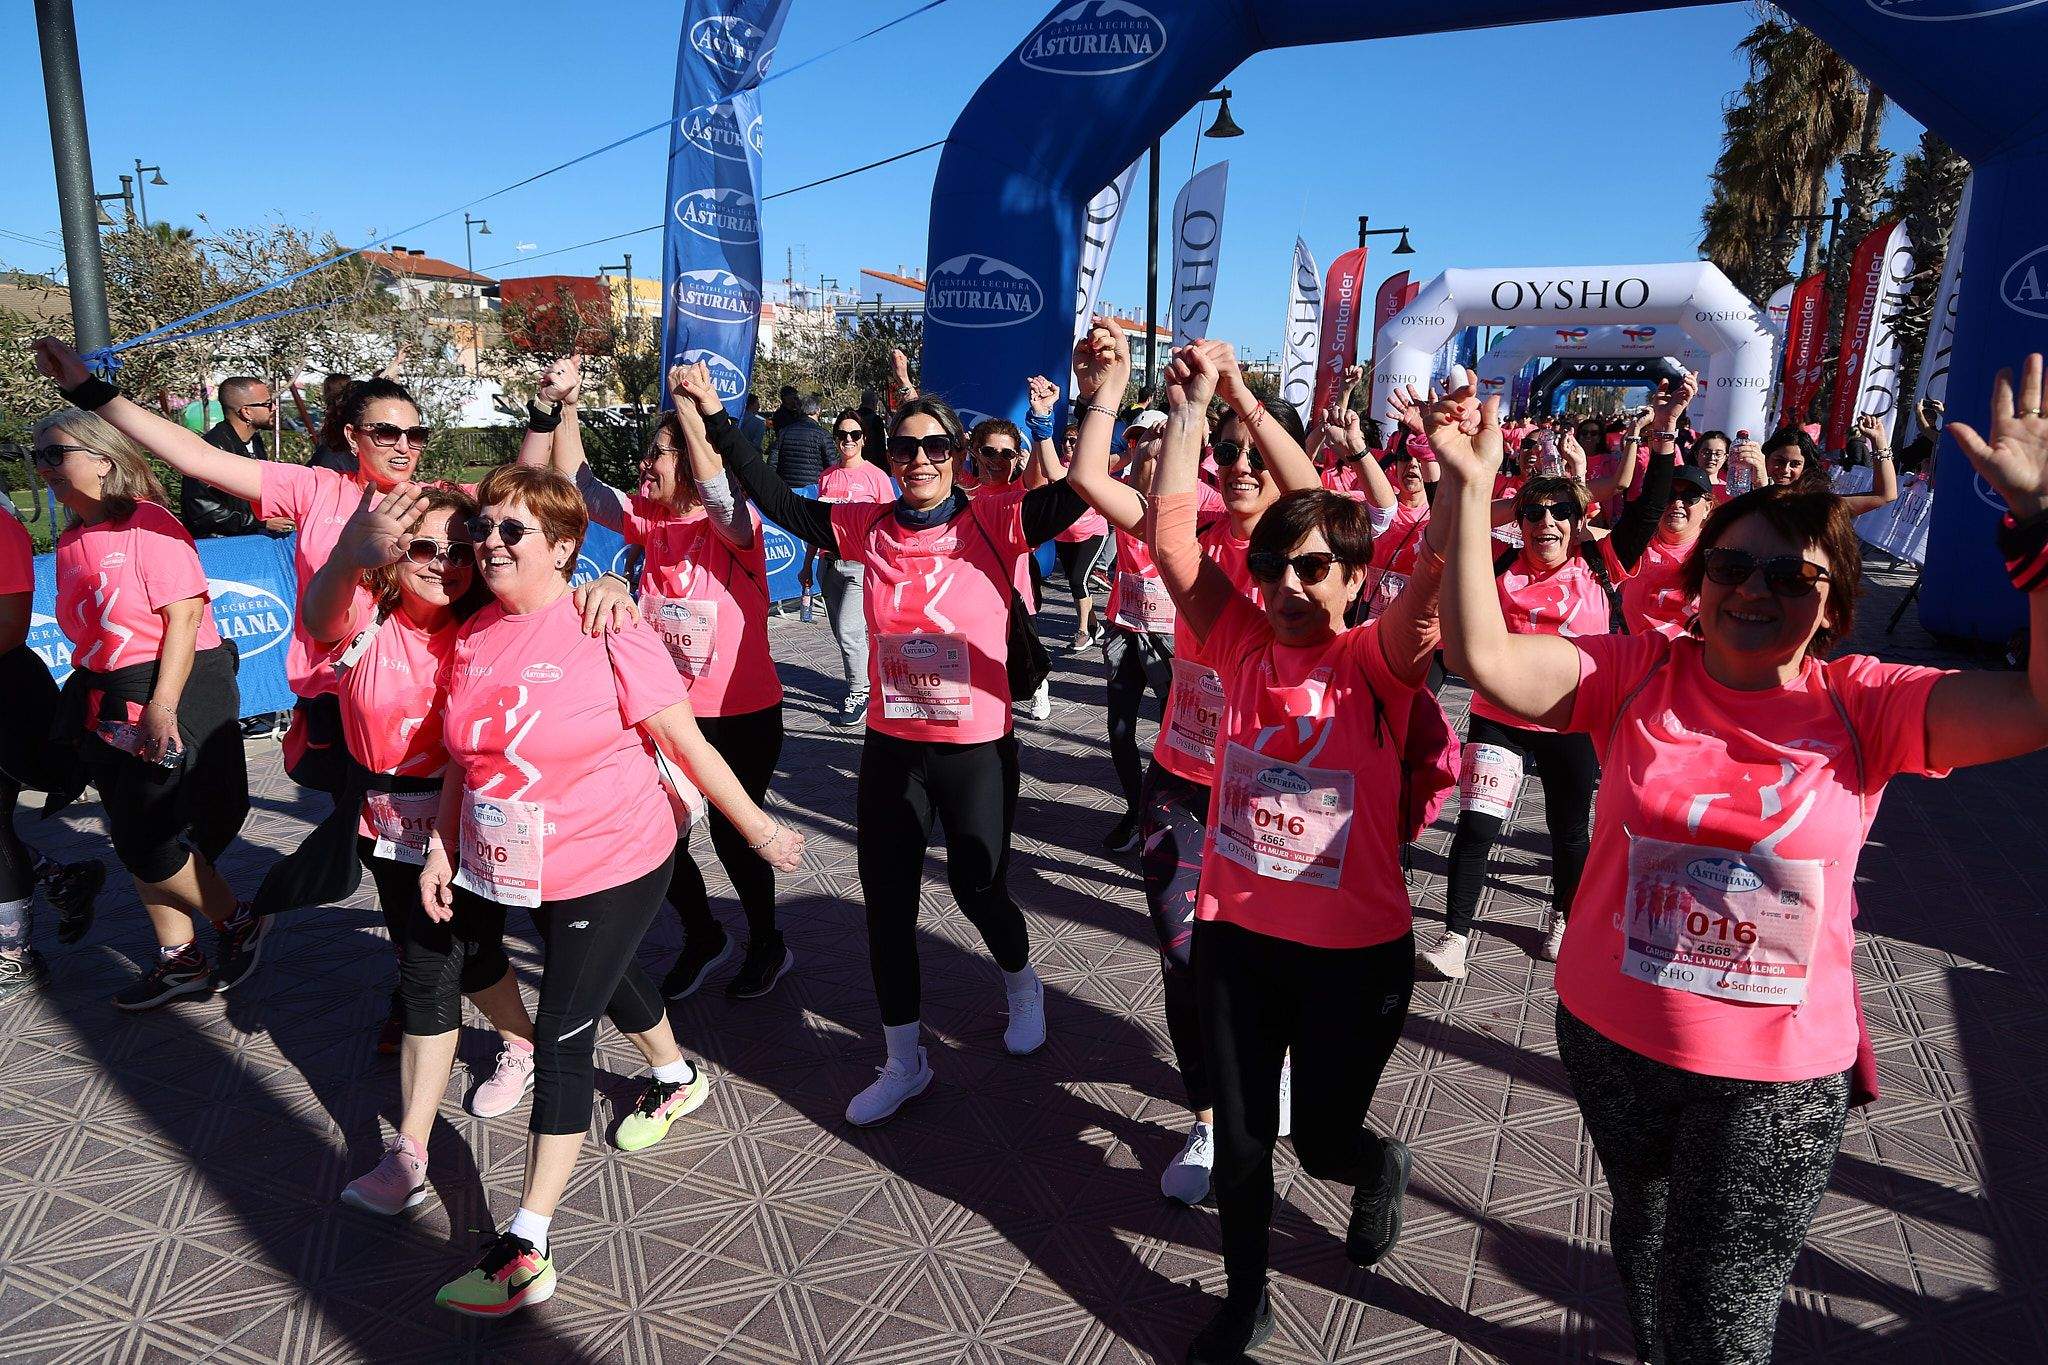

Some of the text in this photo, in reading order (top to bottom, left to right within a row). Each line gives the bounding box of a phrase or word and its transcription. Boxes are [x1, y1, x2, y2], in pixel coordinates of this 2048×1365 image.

[1026, 34, 1153, 60] ASTURIANA
[928, 282, 1032, 312] ASTURIANA
[1491, 278, 1649, 310] OYSHO
[1852, 252, 1883, 350] Santander
[1333, 272, 1354, 351] Santander
[1401, 316, 1445, 326] OYSHO
[1696, 311, 1747, 322] OYSHO
[1797, 296, 1815, 366] Santander
[1573, 364, 1646, 372] VOLVO
[1378, 374, 1416, 384] OYSHO
[1716, 377, 1765, 387] OYSHO
[213, 599, 270, 614] LECHERA
[664, 631, 692, 646] 016
[909, 673, 941, 687] 016
[1260, 773, 1307, 792] ASTURIANA
[1471, 772, 1499, 787] 016
[1254, 808, 1305, 836] 016
[1261, 834, 1285, 847] 4565
[476, 840, 508, 863] 016
[1228, 842, 1325, 878] OYSHO Santander
[1259, 844, 1266, 852] LA
[1268, 847, 1289, 858] MUJER
[1692, 865, 1757, 888] ASTURIANA
[1686, 912, 1757, 945] 016
[1645, 945, 1680, 962] CARRERA
[1696, 955, 1706, 965] LA
[1697, 944, 1731, 957] 4568
[1640, 960, 1789, 996] OYSHO Santander
